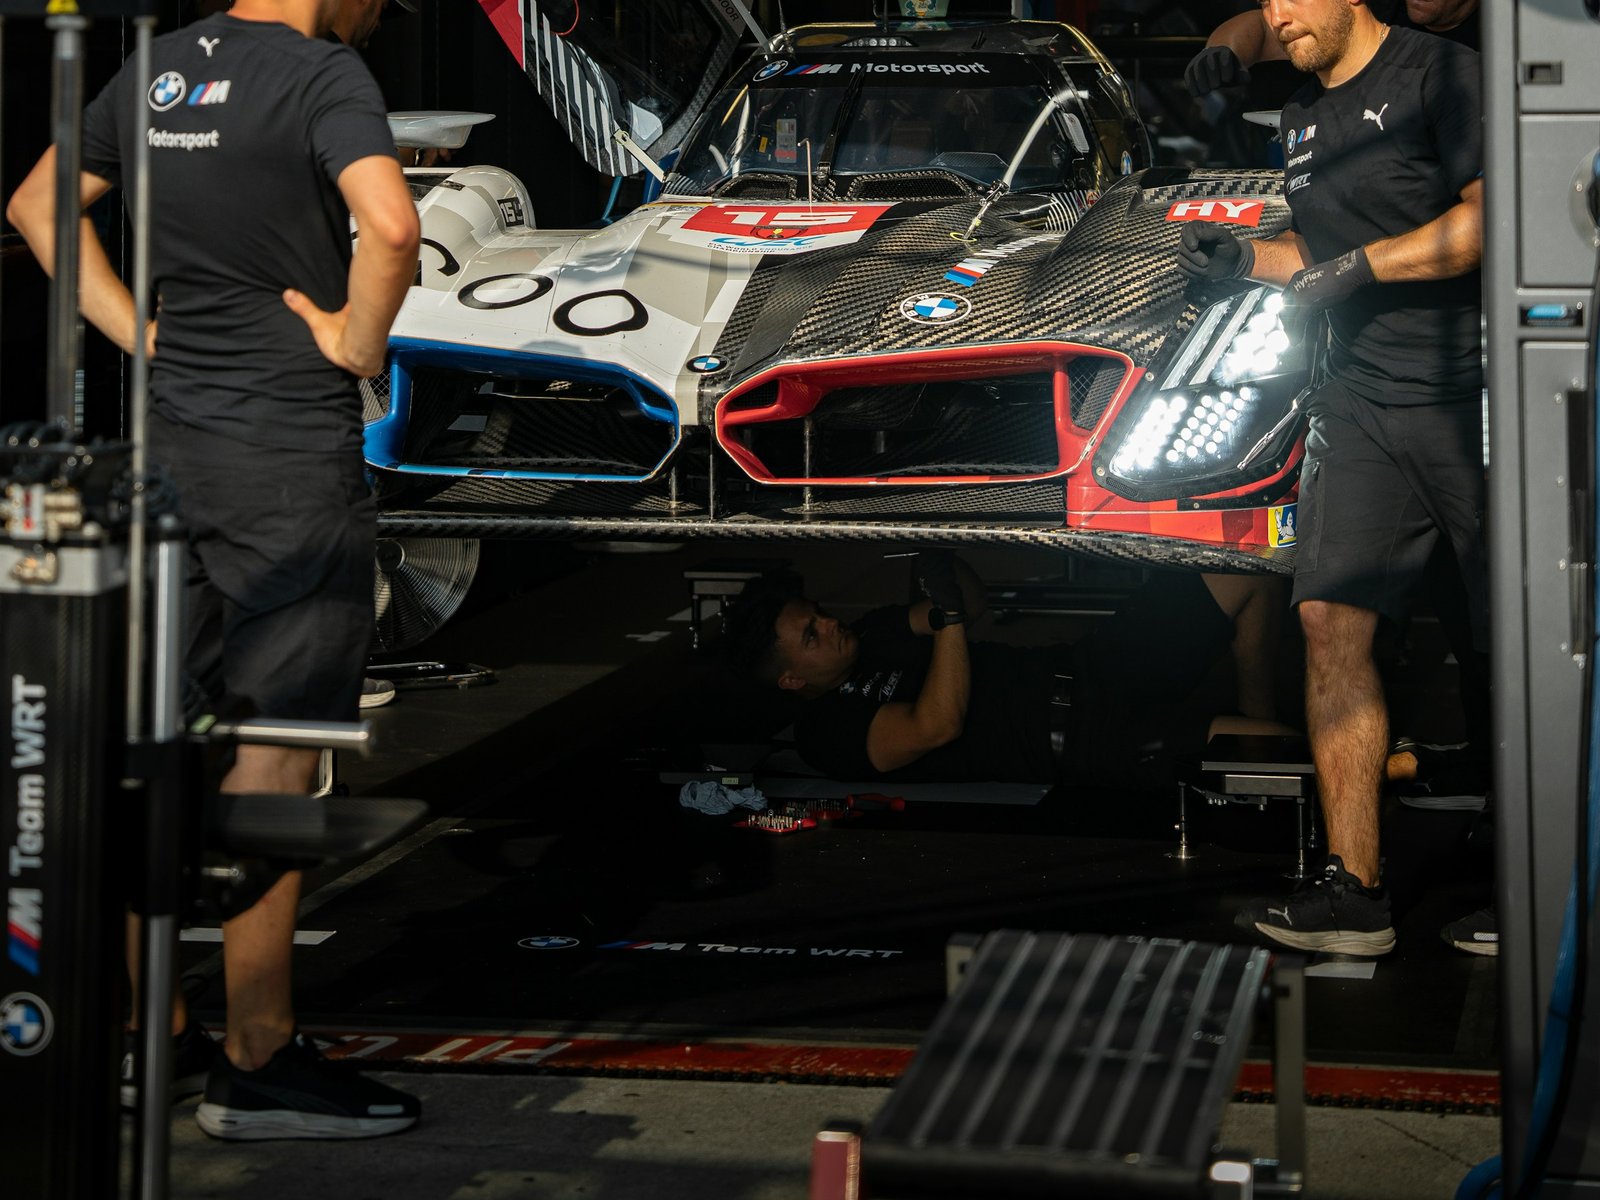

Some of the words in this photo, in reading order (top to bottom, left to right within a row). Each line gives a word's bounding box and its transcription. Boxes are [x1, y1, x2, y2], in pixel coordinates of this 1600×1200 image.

[850, 62, 991, 76] Motorsport
[499, 201, 517, 223] 15
[724, 211, 857, 226] 15
[1172, 201, 1258, 218] HY
[1293, 270, 1323, 293] HyFlex
[11, 673, 47, 769] WRT
[9, 773, 46, 877] Team
[697, 943, 797, 955] Team
[809, 947, 903, 958] WRT
